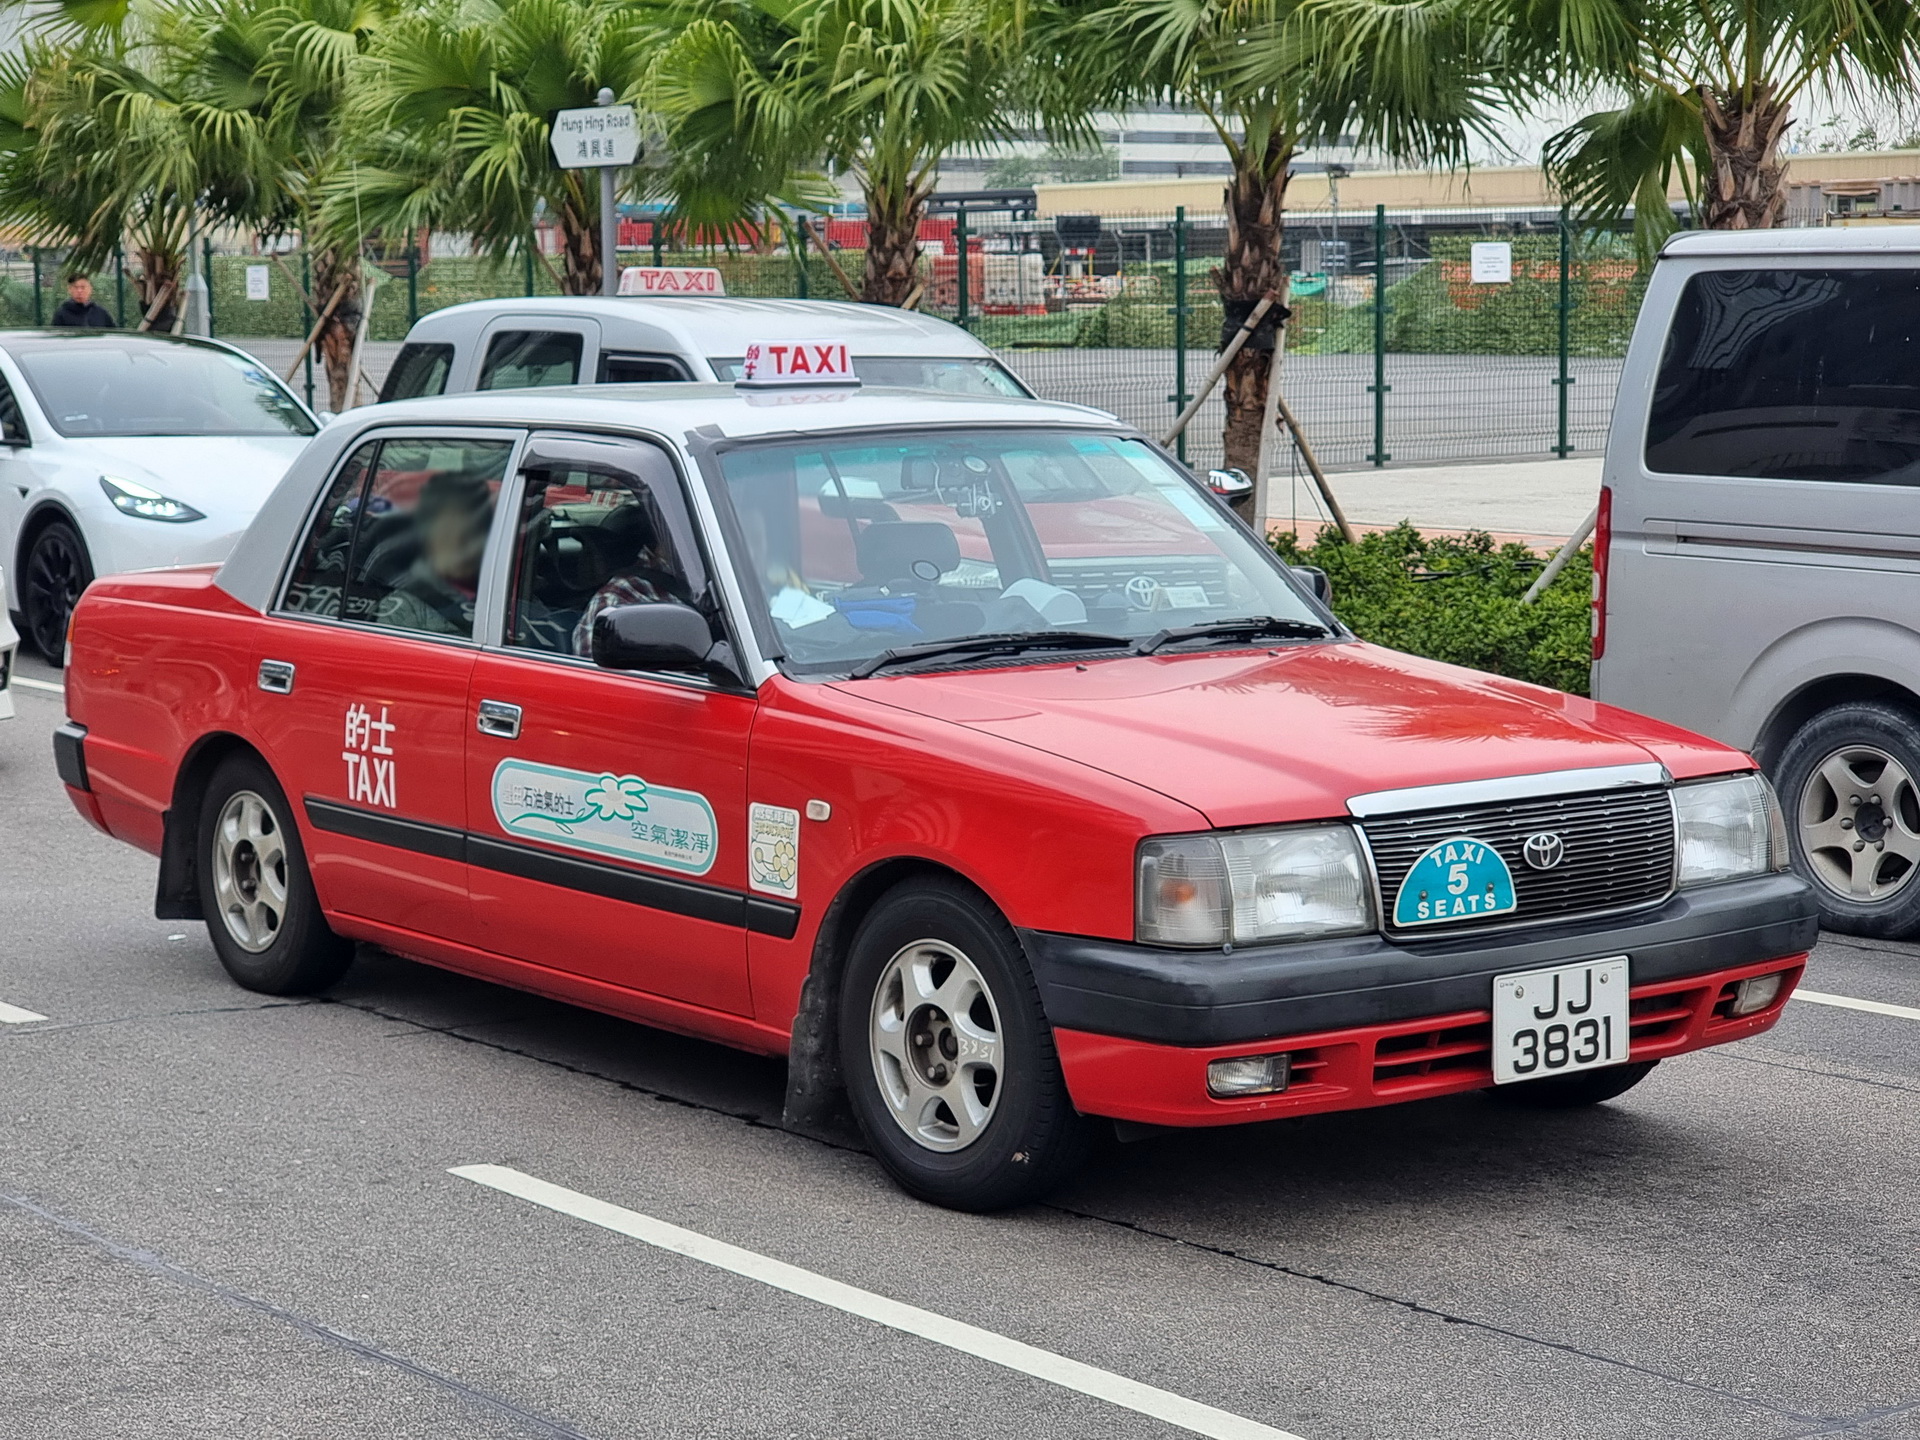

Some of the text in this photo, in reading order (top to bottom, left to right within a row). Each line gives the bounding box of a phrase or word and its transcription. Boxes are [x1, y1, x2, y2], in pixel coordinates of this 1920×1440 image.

[561, 112, 630, 133] Hung Hing Road
[640, 270, 714, 291] TAXI
[768, 345, 846, 374] TAXI
[345, 702, 396, 756] 的士
[342, 751, 396, 808] TAXI
[631, 819, 709, 853] 空氣潔淨
[1430, 843, 1485, 867] TAXI
[1447, 863, 1469, 895] 5
[1417, 892, 1496, 919] SEATS
[1533, 969, 1592, 1019] JJ
[1513, 1015, 1611, 1074] 3831
